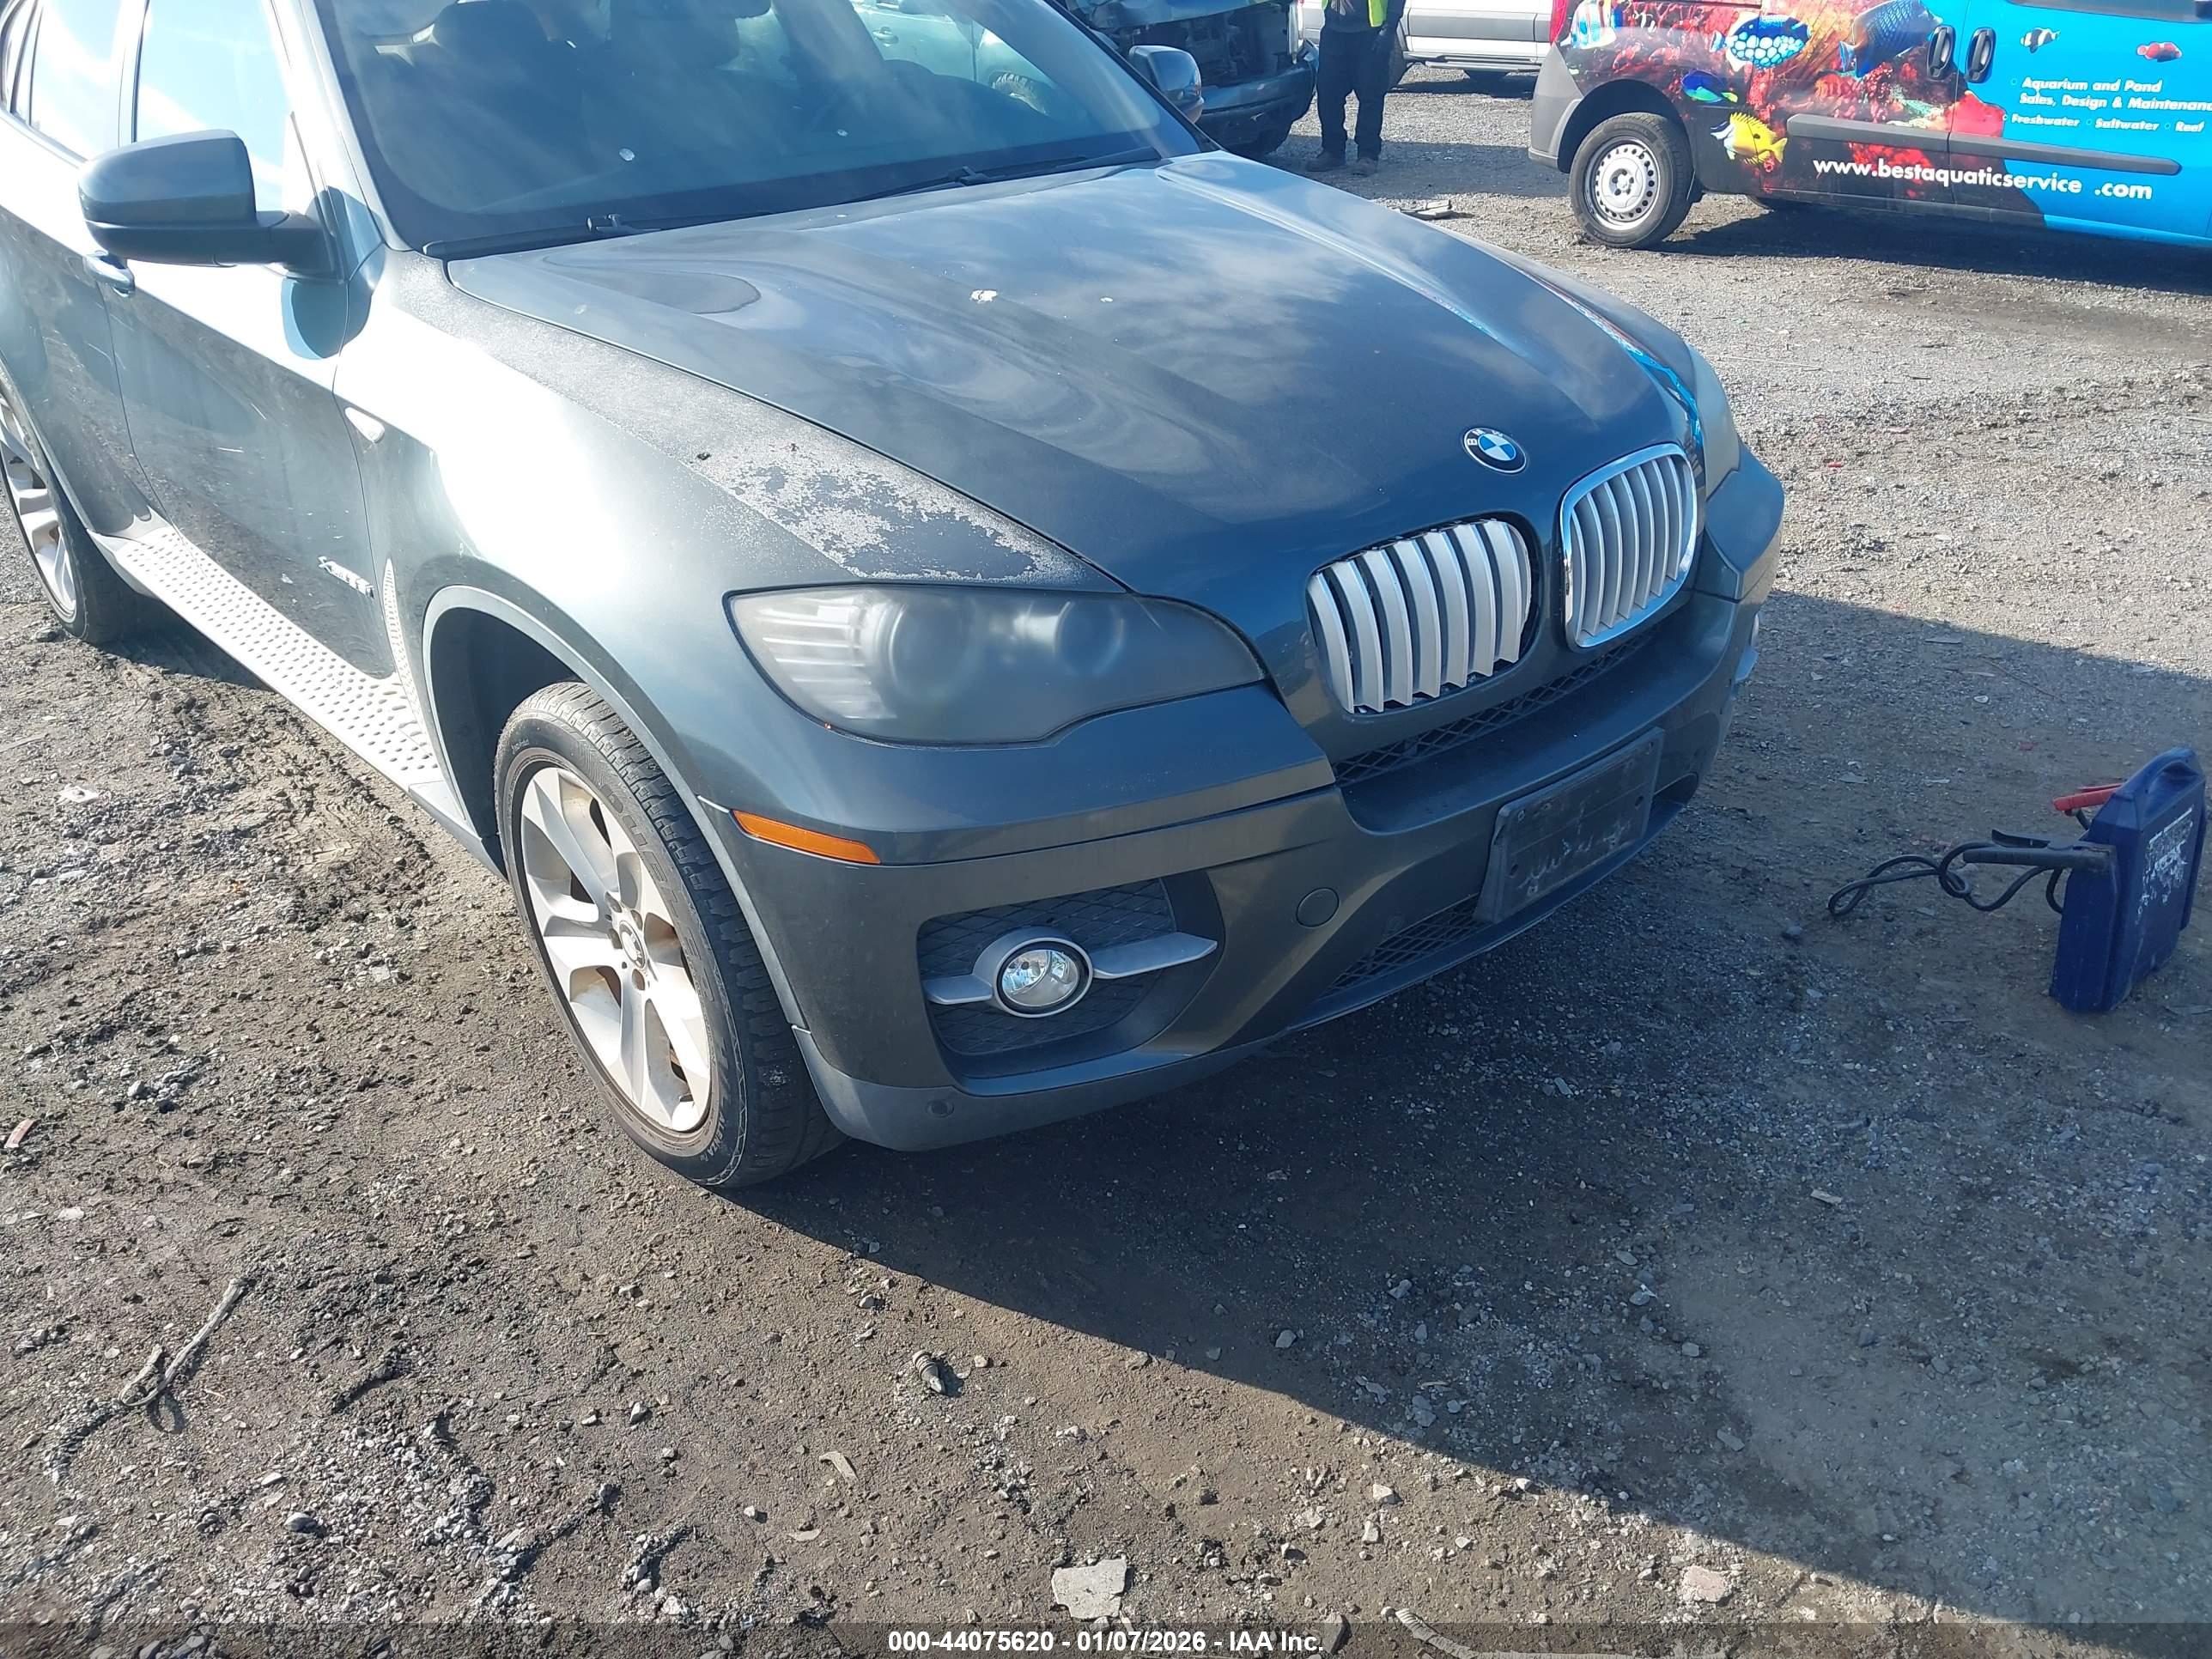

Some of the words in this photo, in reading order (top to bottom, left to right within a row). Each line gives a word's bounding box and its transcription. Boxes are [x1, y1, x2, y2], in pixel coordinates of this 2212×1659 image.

[2022, 76, 2087, 94] Aquarium
[2093, 78, 2121, 92] and
[2124, 79, 2163, 93] Pond
[2020, 92, 2057, 107] Sales,
[2062, 94, 2107, 110] Design
[2112, 96, 2122, 108] &
[2011, 113, 2080, 127] Freshwater
[2094, 118, 2160, 131] Saltwater
[2175, 121, 2205, 132] Reef
[1813, 158, 2082, 193] www.bestaquaticservice
[2094, 182, 2153, 199] .com
[707, 1111, 726, 1158] ALENZA
